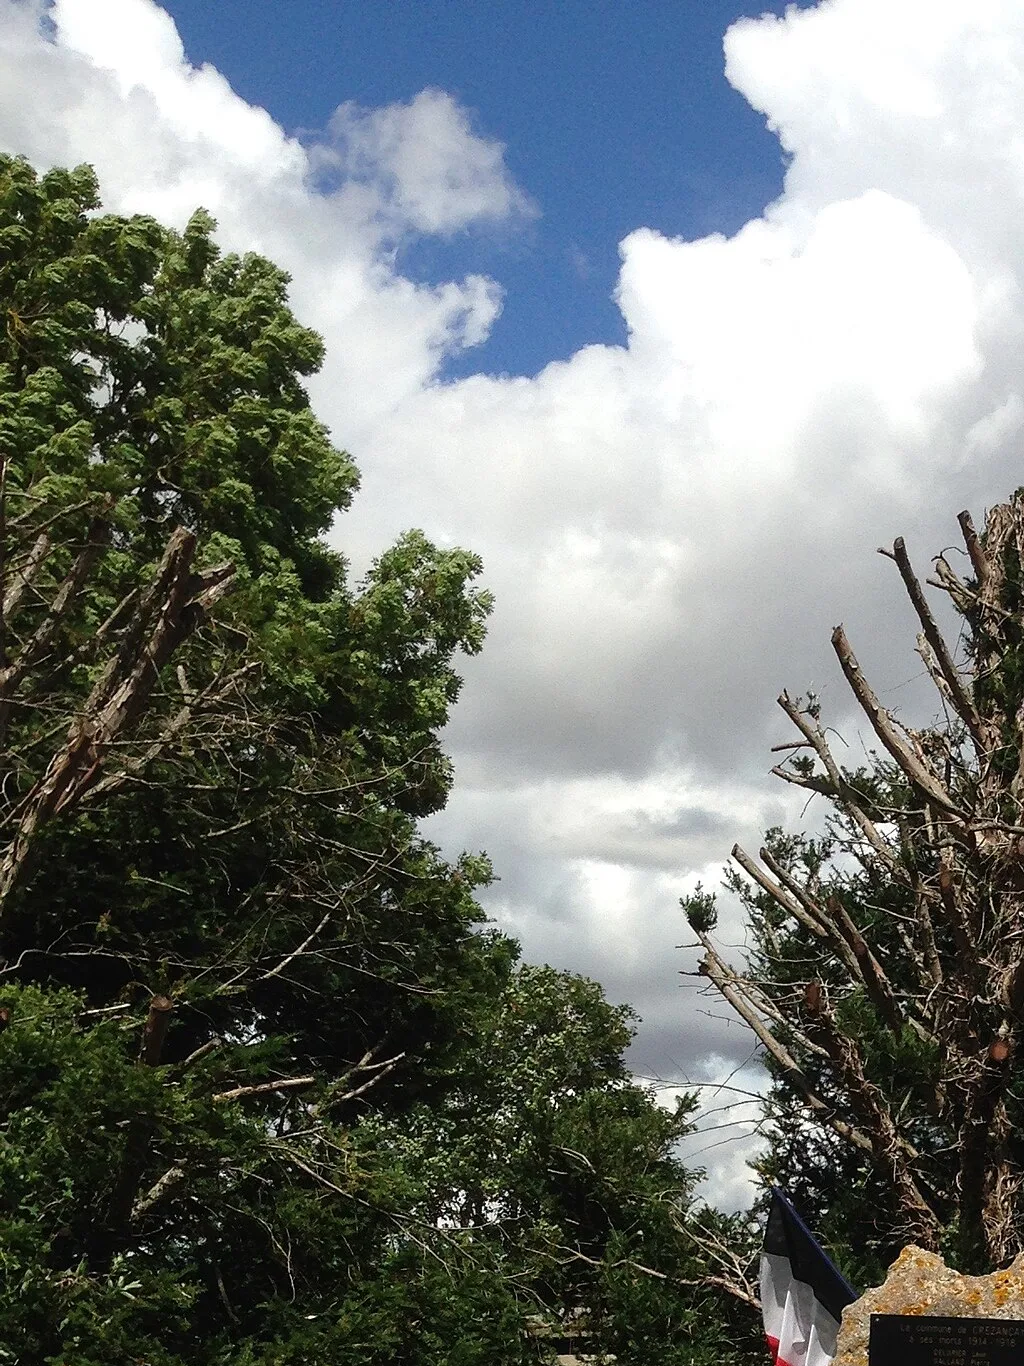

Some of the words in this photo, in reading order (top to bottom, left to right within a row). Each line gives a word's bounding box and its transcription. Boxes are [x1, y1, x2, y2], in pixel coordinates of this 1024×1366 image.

[916, 1326, 951, 1334] commune
[957, 1326, 967, 1334] de
[939, 1336, 962, 1345] morts
